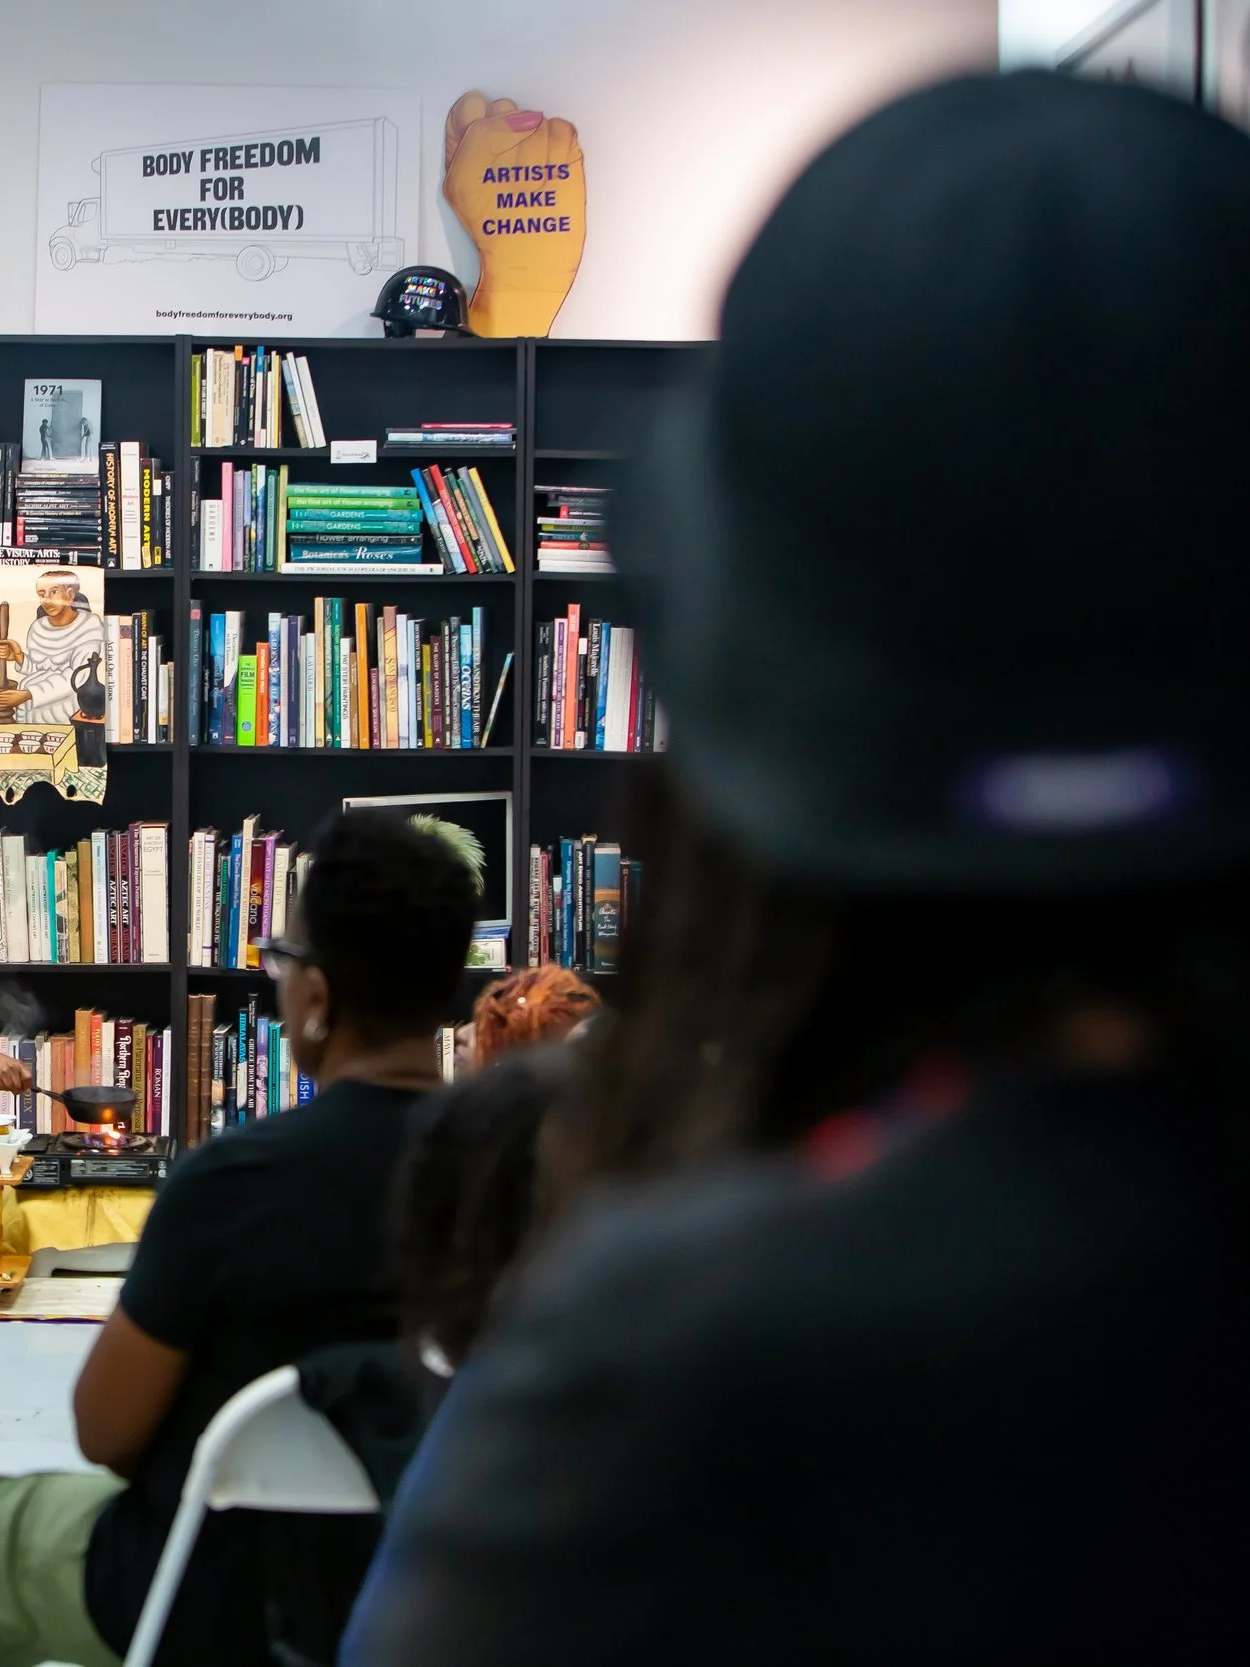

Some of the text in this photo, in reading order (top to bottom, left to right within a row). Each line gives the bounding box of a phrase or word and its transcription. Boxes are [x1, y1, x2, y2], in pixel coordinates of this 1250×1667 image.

[142, 136, 321, 178] BODY FREEDOM
[482, 163, 570, 184] ARTISTS
[200, 176, 244, 202] FOR
[497, 190, 557, 209] MAKE
[153, 205, 304, 231] EVERY(BODY)
[482, 216, 571, 236] CHANGE
[403, 276, 446, 291] ARTISTS
[407, 284, 436, 297] MAKE
[399, 294, 443, 311] FUTURES
[156, 310, 293, 321] bodyfreedomforeverybody.org
[33, 385, 63, 396] 1971
[105, 453, 116, 488] HISTORY
[107, 489, 115, 500] OF
[143, 468, 151, 521] MODERN
[107, 502, 117, 536] MODERN
[8, 549, 35, 558] VISUAL
[36, 549, 61, 558] ARTS:
[108, 537, 117, 555] ART
[302, 546, 394, 560] Botanica's Roses
[141, 630, 148, 638] OF
[270, 631, 280, 668] GARDENS
[590, 623, 600, 677] Louis Majorelle
[461, 666, 472, 711] OCEANS
[249, 882, 261, 924] volcano
[239, 1013, 247, 1062] HIMALAYAS
[115, 1035, 131, 1069] Northern
